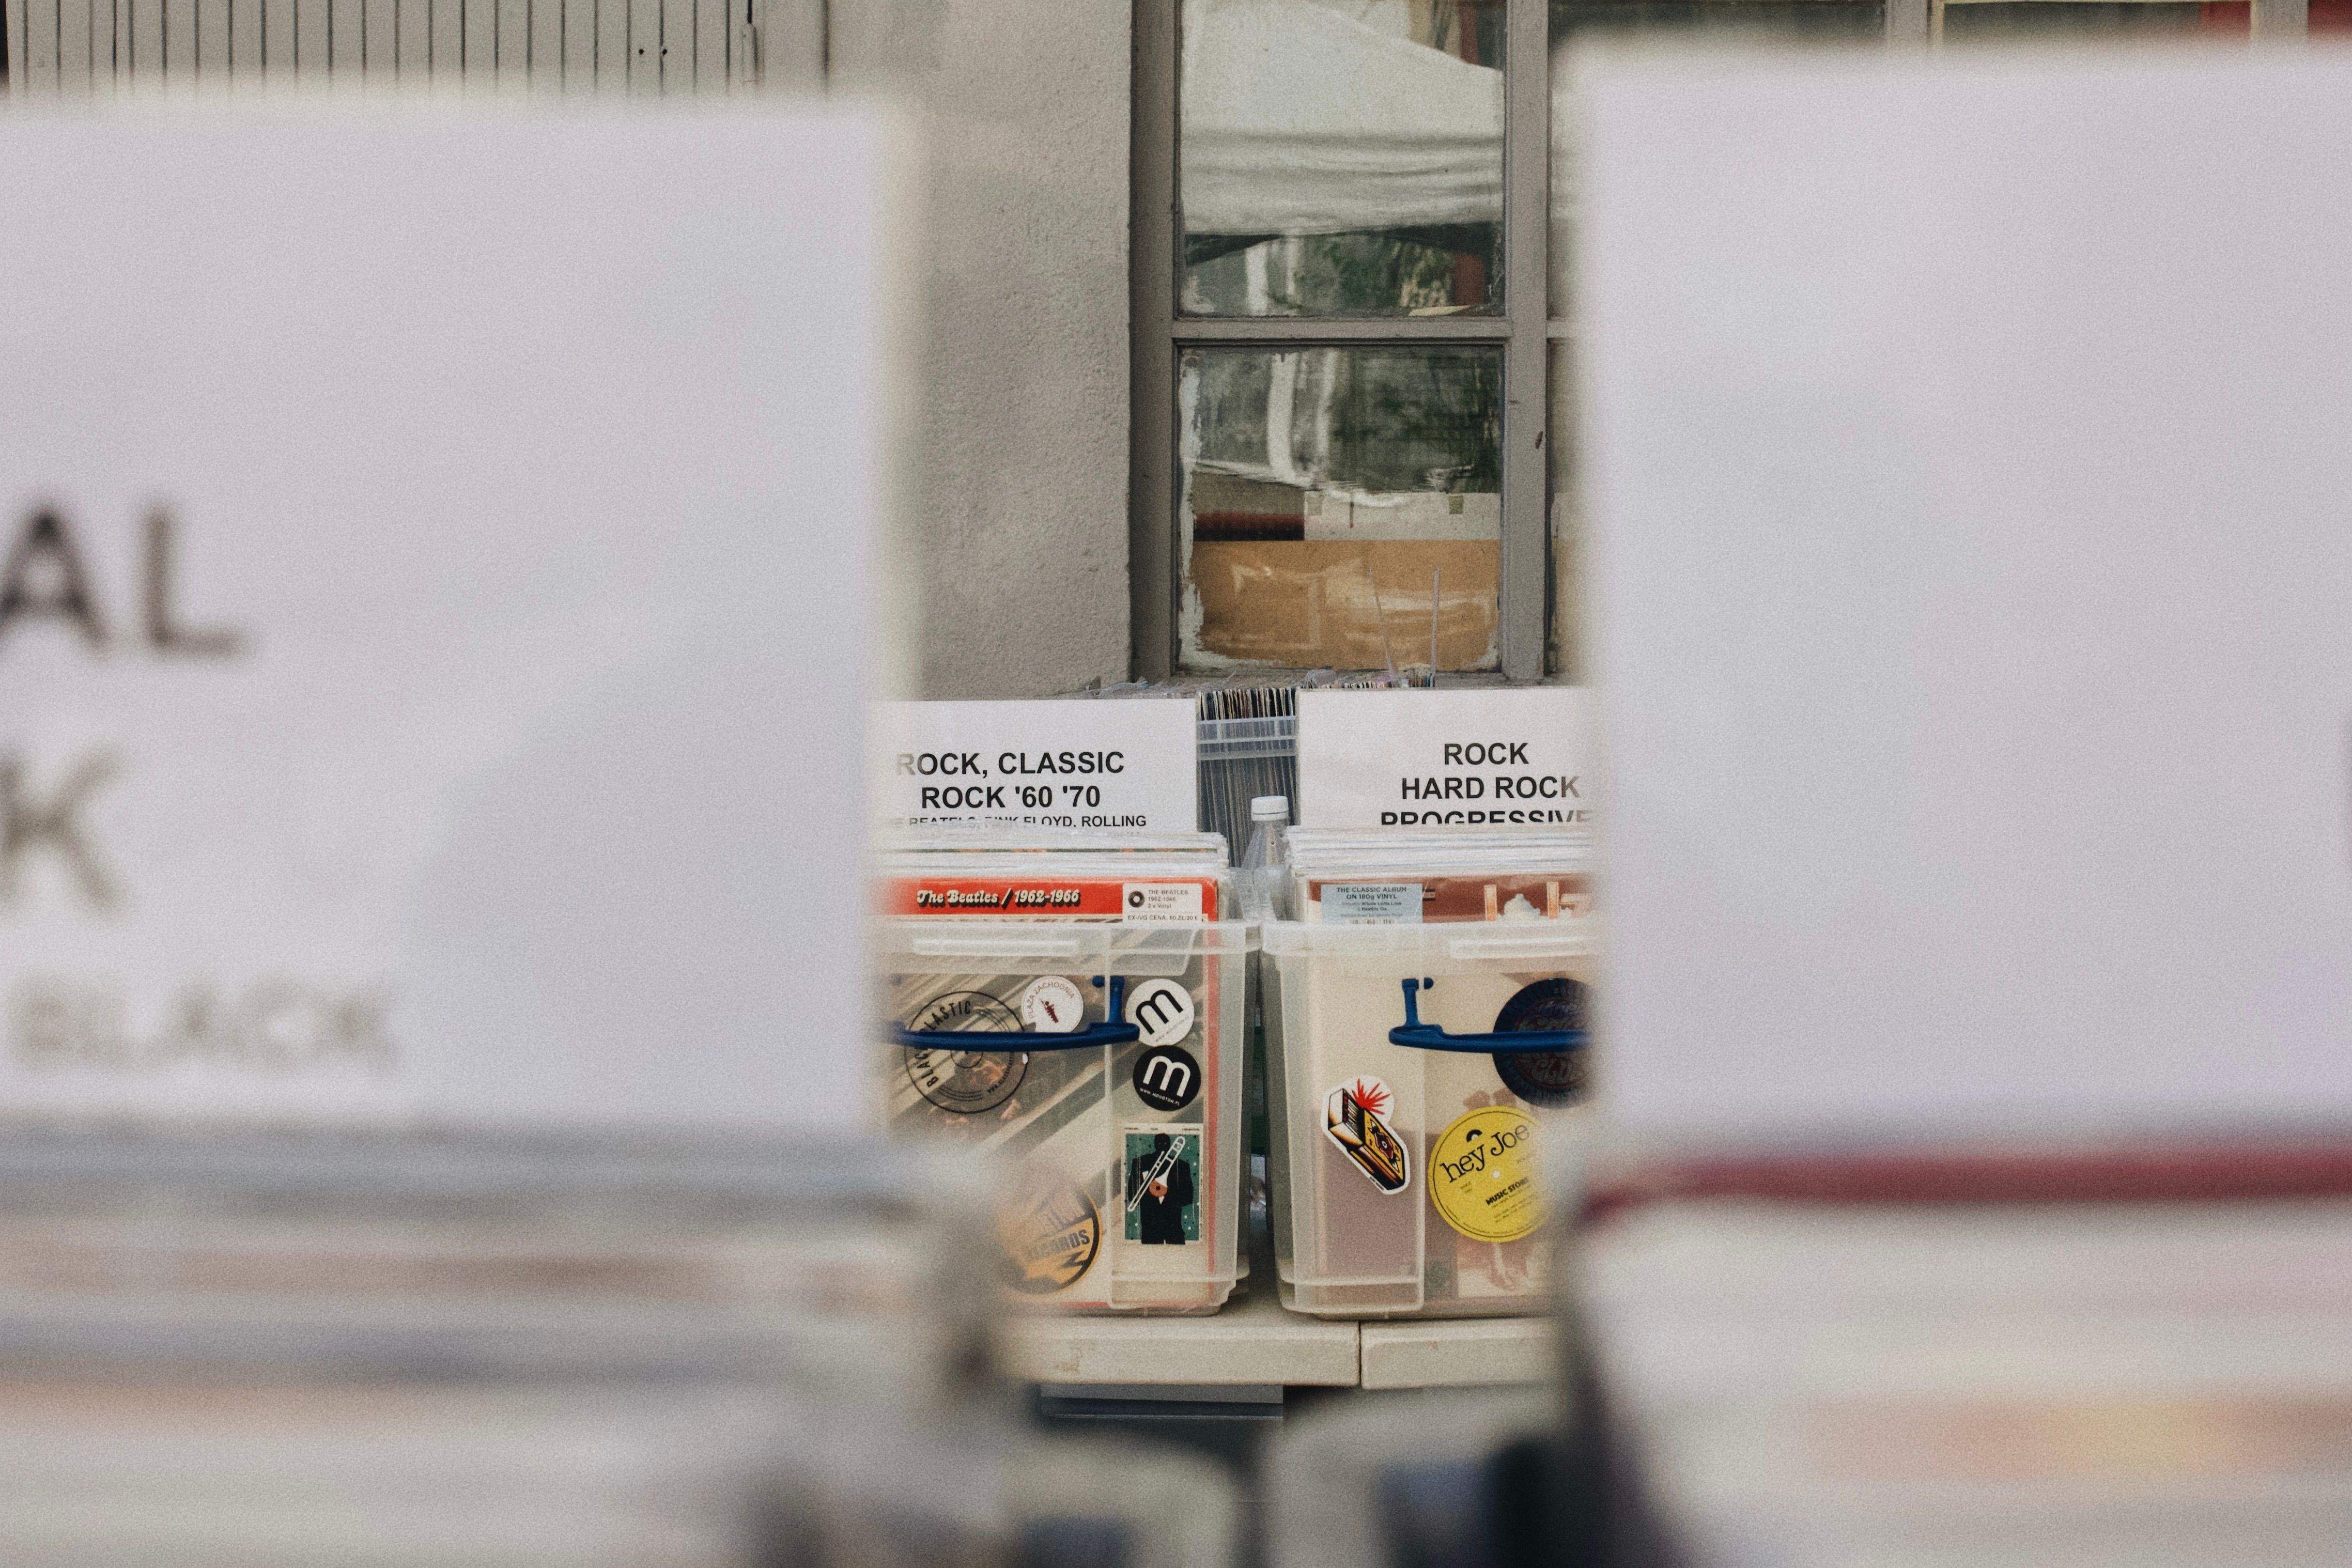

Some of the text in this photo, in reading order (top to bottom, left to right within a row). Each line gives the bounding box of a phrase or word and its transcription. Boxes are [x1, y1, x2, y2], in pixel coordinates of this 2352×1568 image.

[896, 751, 1124, 779] ROCK, CLASSIC
[1444, 742, 1529, 765] ROCK
[922, 785, 1101, 809] ROCK '60 '70
[1402, 776, 1580, 799] HARD ROCK
[1081, 815, 1147, 827] ROLLING
[916, 890, 946, 908] The
[946, 890, 1000, 908] Beatles
[1014, 889, 1081, 908] 1962-1966
[1034, 982, 1075, 999] ZACHODNIA
[914, 1001, 971, 1087] BLAC LASTIC
[1440, 1124, 1530, 1183] hey Joe
[1486, 1188, 1509, 1206] MUSIC
